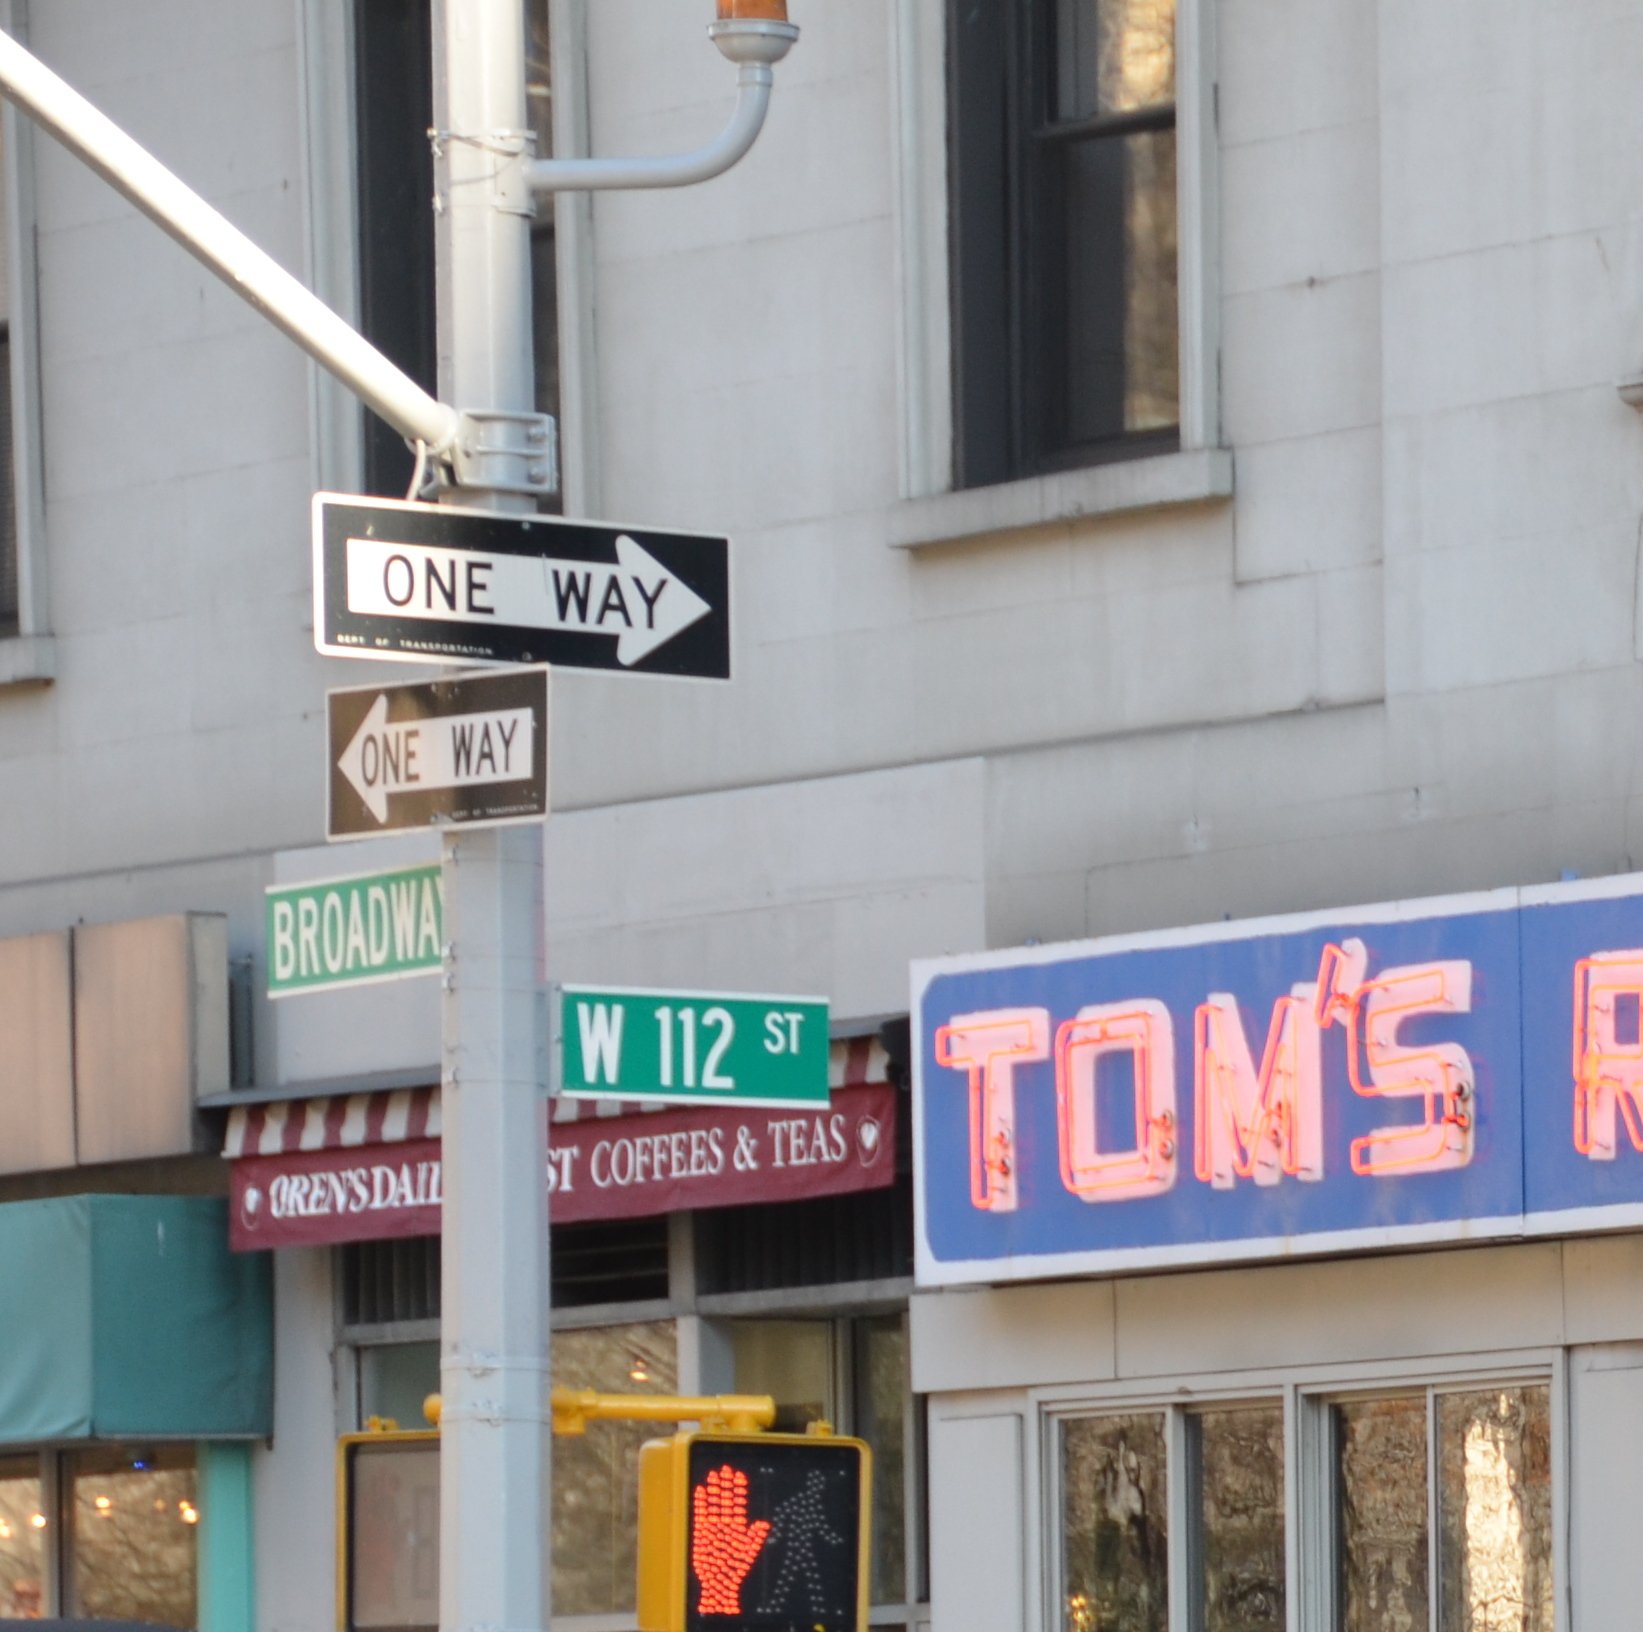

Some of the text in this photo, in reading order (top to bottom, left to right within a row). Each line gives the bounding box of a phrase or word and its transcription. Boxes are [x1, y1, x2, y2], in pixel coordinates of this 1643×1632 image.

[383, 554, 668, 629] ONE WAY
[400, 639, 494, 655] TRANSPORTATION
[361, 718, 517, 787] ONE WAY
[576, 1002, 804, 1090] W 112 ST
[935, 937, 1475, 1212] TOM'S
[269, 1167, 369, 1218] OREN'S
[369, 1160, 442, 1210] DAIL
[590, 1127, 725, 1188] COFFEES
[733, 1127, 759, 1171] &
[767, 1114, 848, 1168] TEAS
